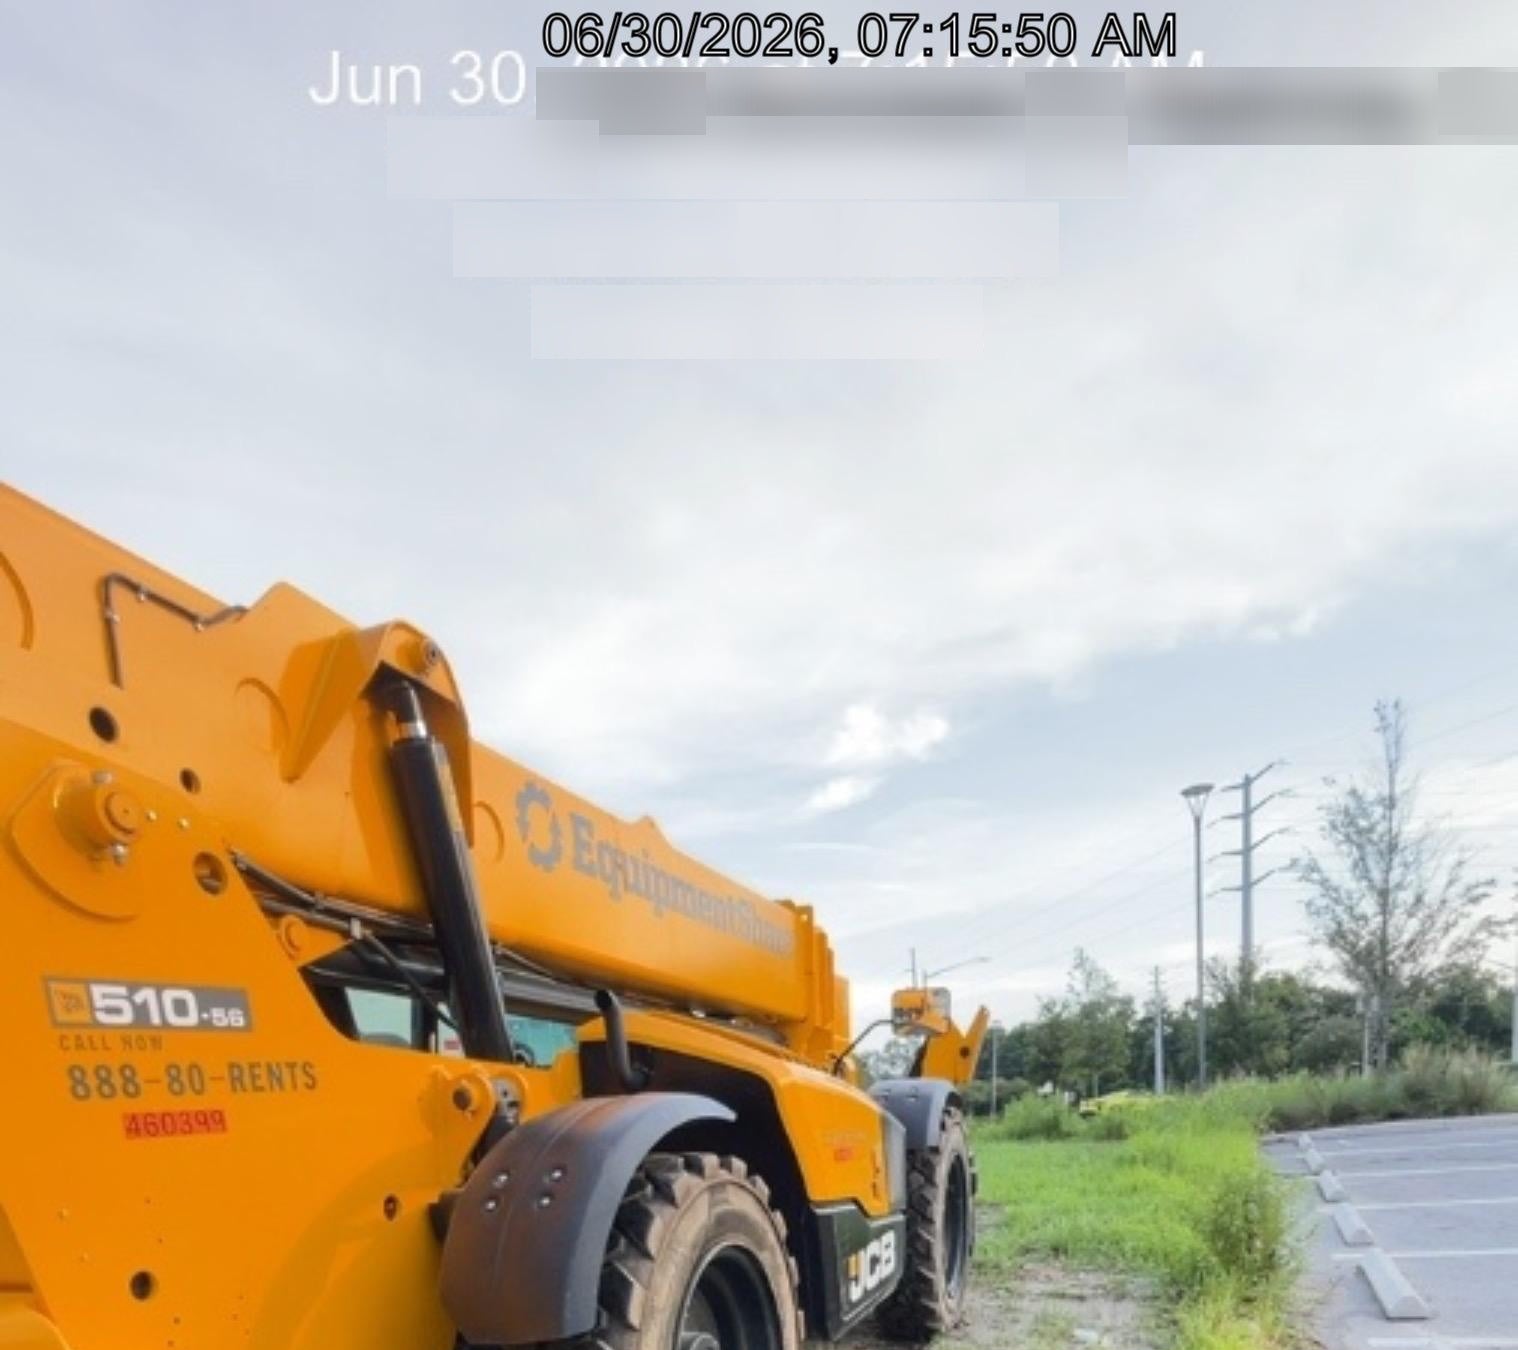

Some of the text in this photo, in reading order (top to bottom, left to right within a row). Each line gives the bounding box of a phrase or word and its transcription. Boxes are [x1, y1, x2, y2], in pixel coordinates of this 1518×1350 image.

[58, 1034, 164, 1051] CALL NOW
[66, 1060, 318, 1101] 888-80-RENTS
[125, 1110, 227, 1138] 460399
[847, 1230, 895, 1302] JCB
